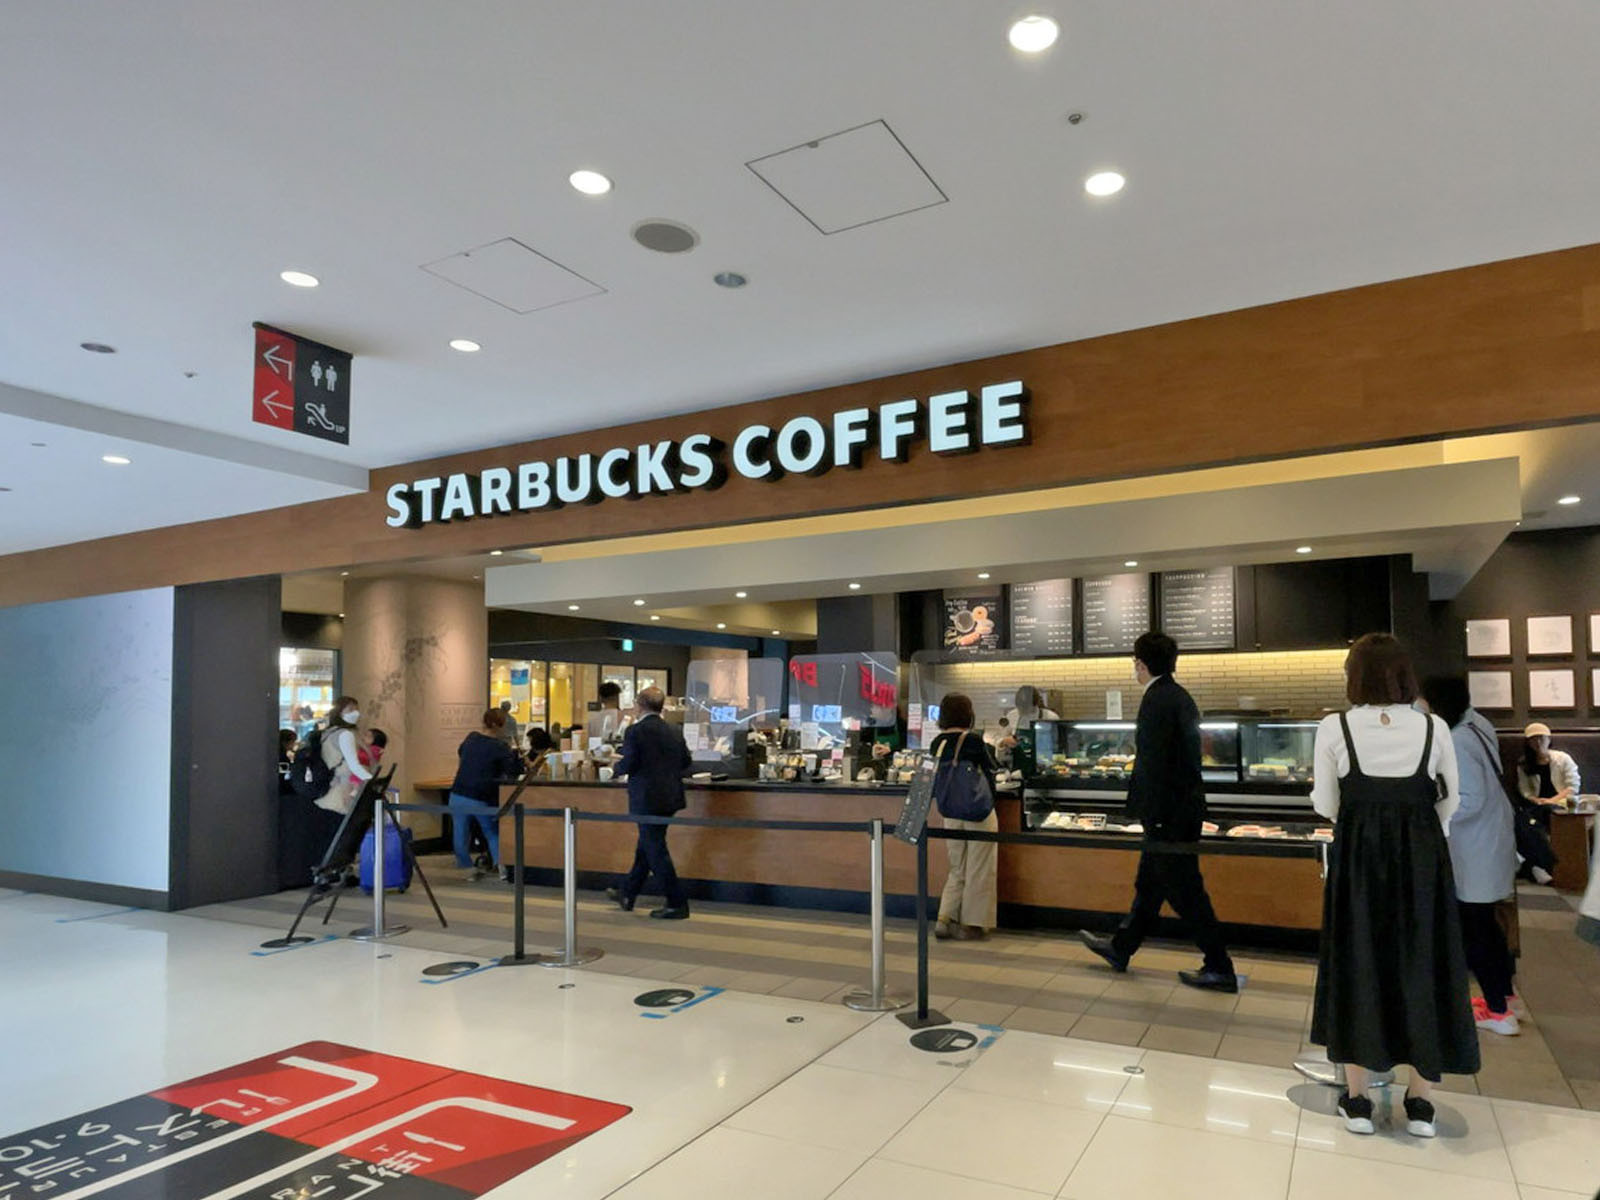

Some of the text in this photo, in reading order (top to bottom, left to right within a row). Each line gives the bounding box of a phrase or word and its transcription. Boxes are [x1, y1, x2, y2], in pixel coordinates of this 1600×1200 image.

[335, 424, 346, 434] UP
[385, 380, 1024, 527] STARBUCKS COFFEE
